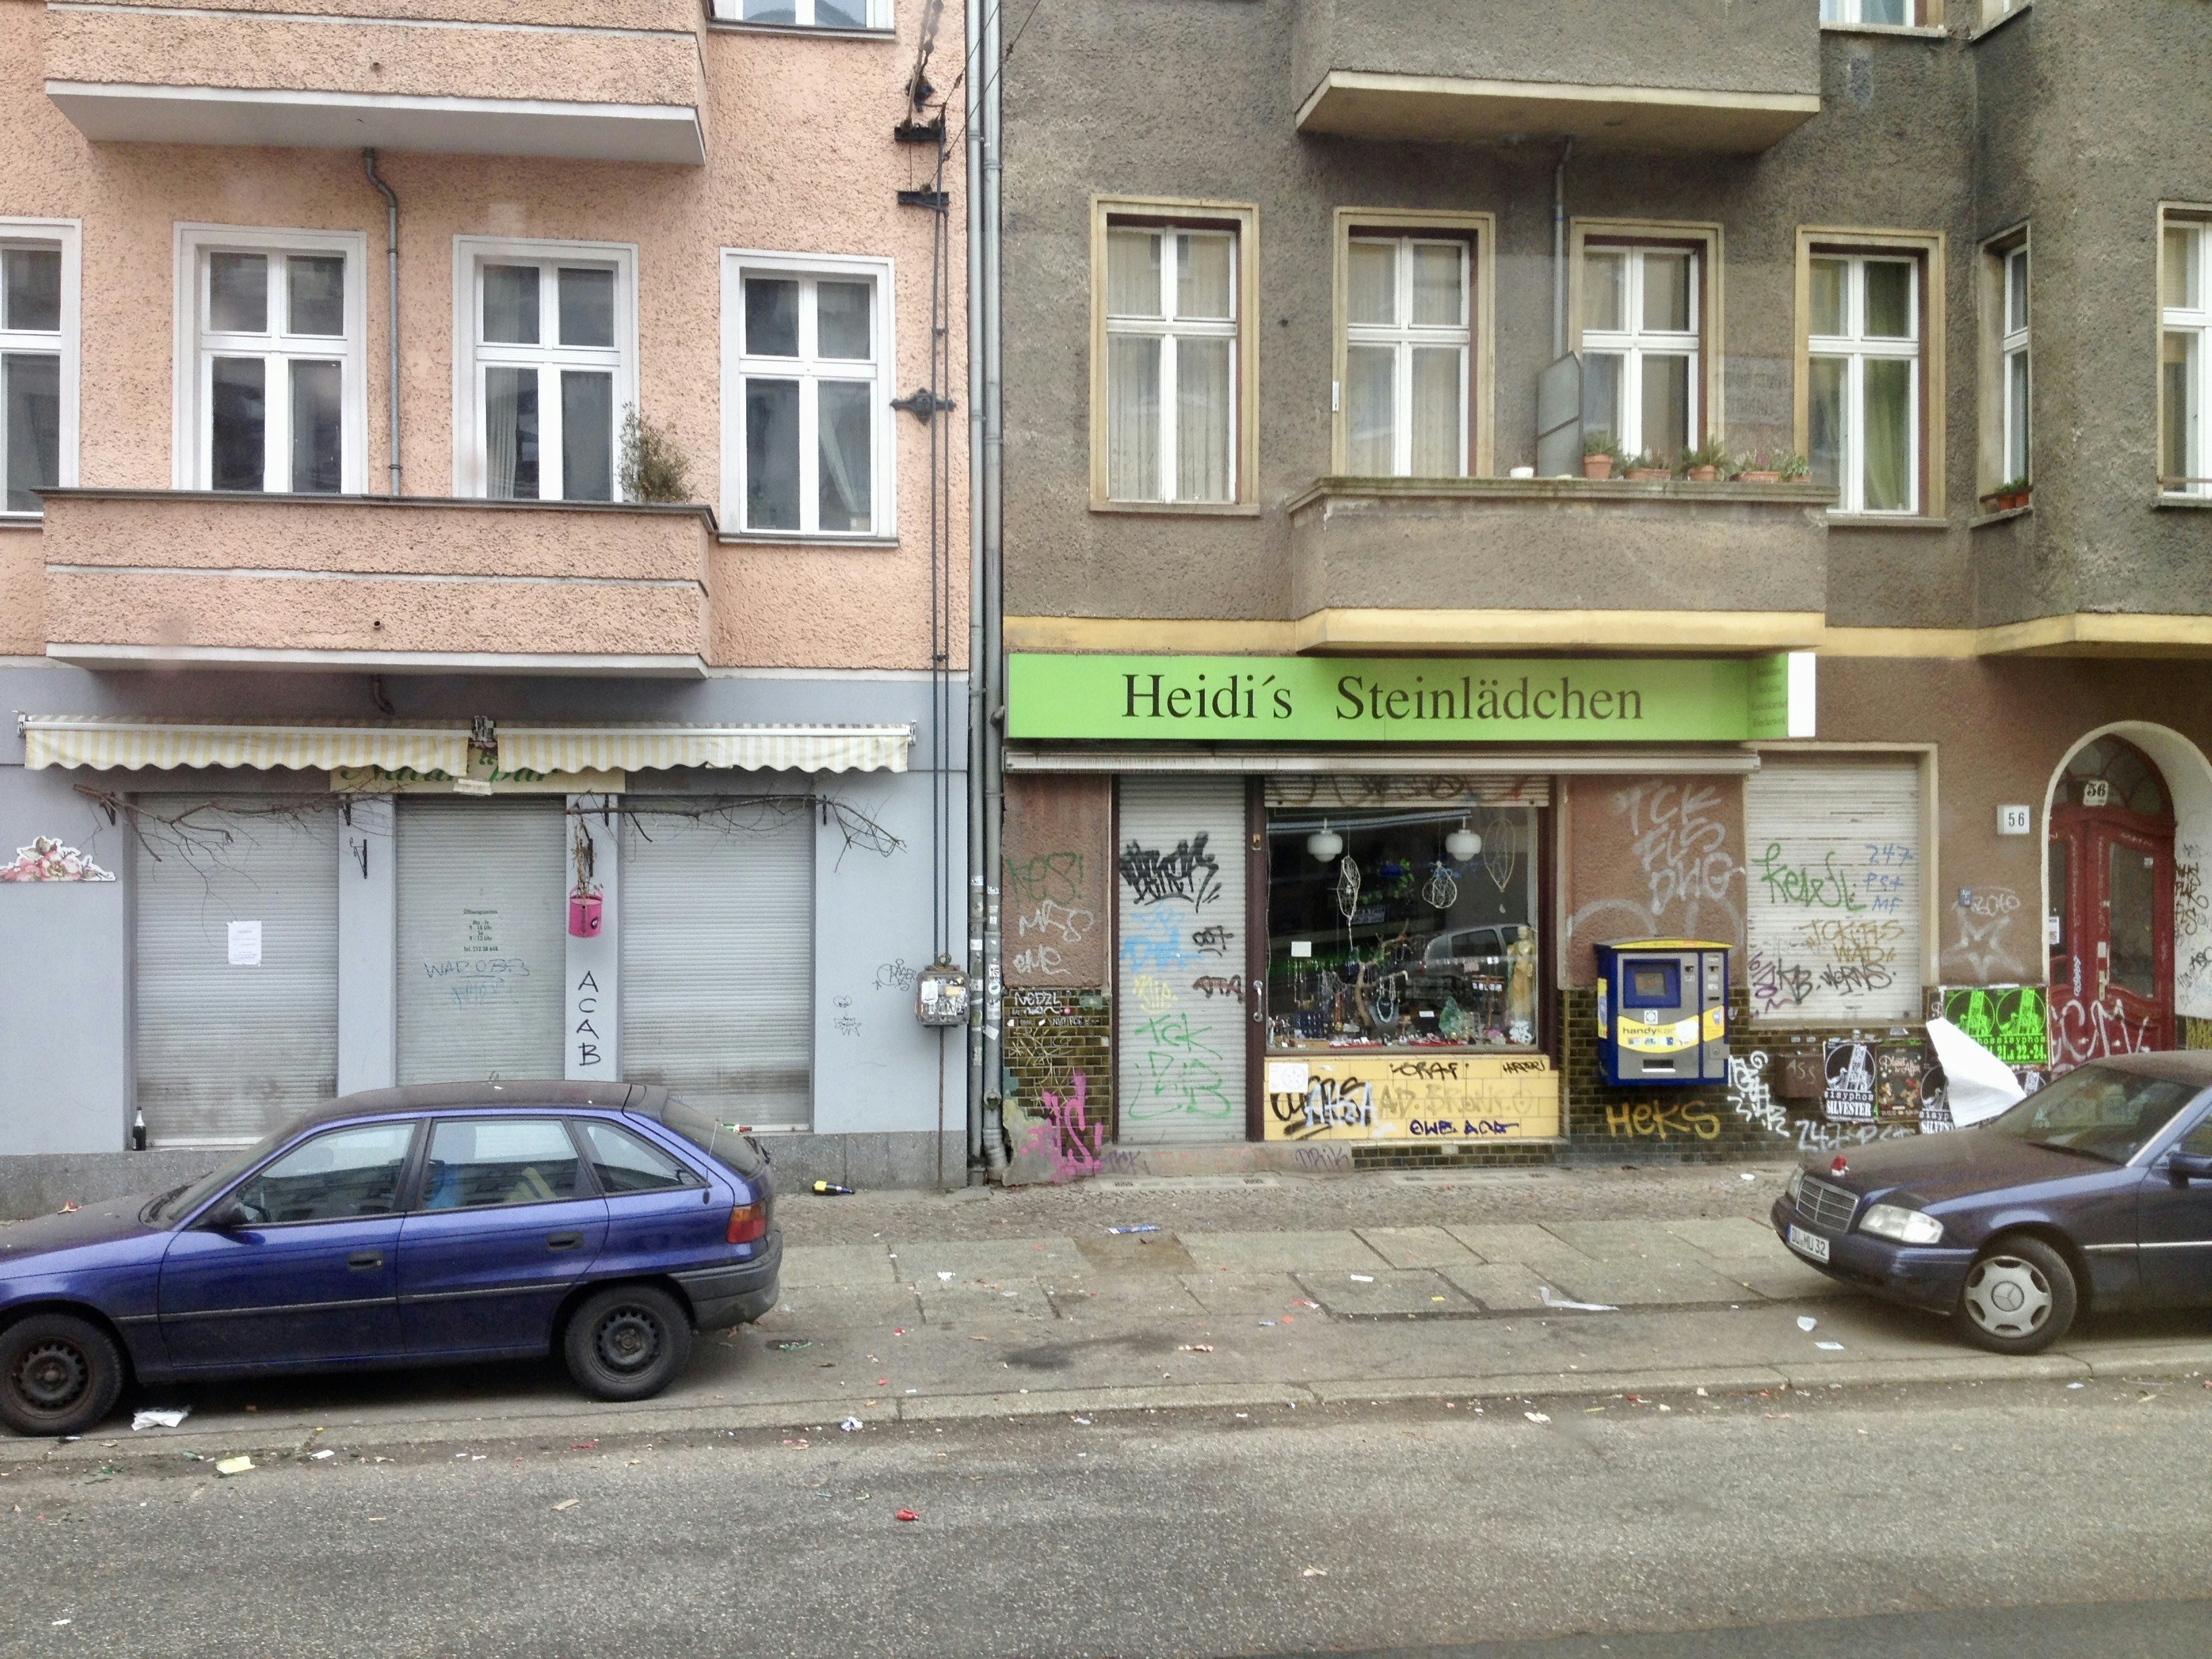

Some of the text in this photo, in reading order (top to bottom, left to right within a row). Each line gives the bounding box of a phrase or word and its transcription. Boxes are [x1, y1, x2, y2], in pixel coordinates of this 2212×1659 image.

[1336, 676, 1643, 720] Steinlädchen
[2087, 783, 2106, 797] 56
[2008, 812, 2025, 827] 56
[576, 970, 601, 1066] ACAB
[1824, 1090, 1874, 1102] sisyphos
[1826, 1100, 1871, 1118] SILVESTER
[1815, 1239, 1826, 1257] 32
